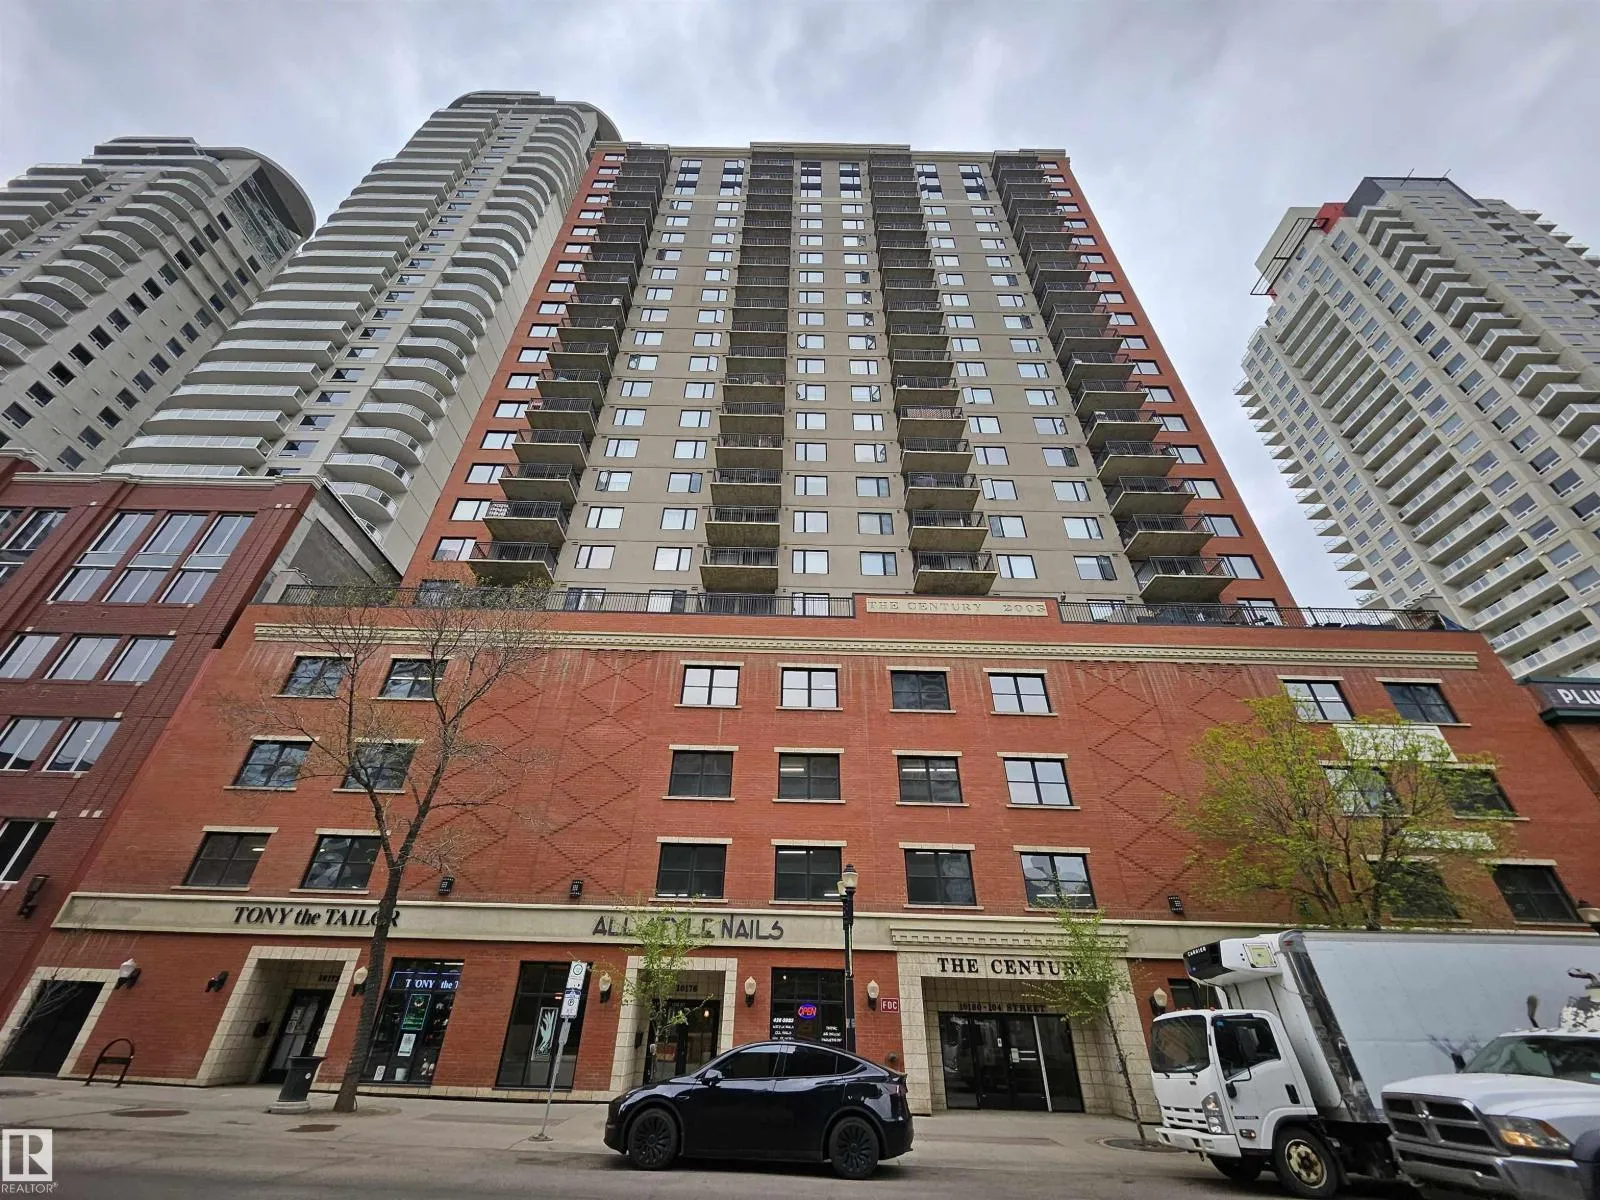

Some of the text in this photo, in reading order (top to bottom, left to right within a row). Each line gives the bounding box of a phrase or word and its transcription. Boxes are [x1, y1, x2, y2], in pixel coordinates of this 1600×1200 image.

[868, 600, 900, 611] THE
[907, 601, 982, 613] CENTURY
[1557, 688, 1600, 705] PLU
[234, 906, 293, 925] TONY
[294, 908, 321, 925] the
[592, 915, 635, 937] ALL
[721, 914, 785, 941] NAILS
[937, 957, 1084, 976] THE CENTUR
[676, 983, 699, 993] 10176
[798, 1006, 817, 1016] OPEN
[882, 1000, 898, 1010] FDC
